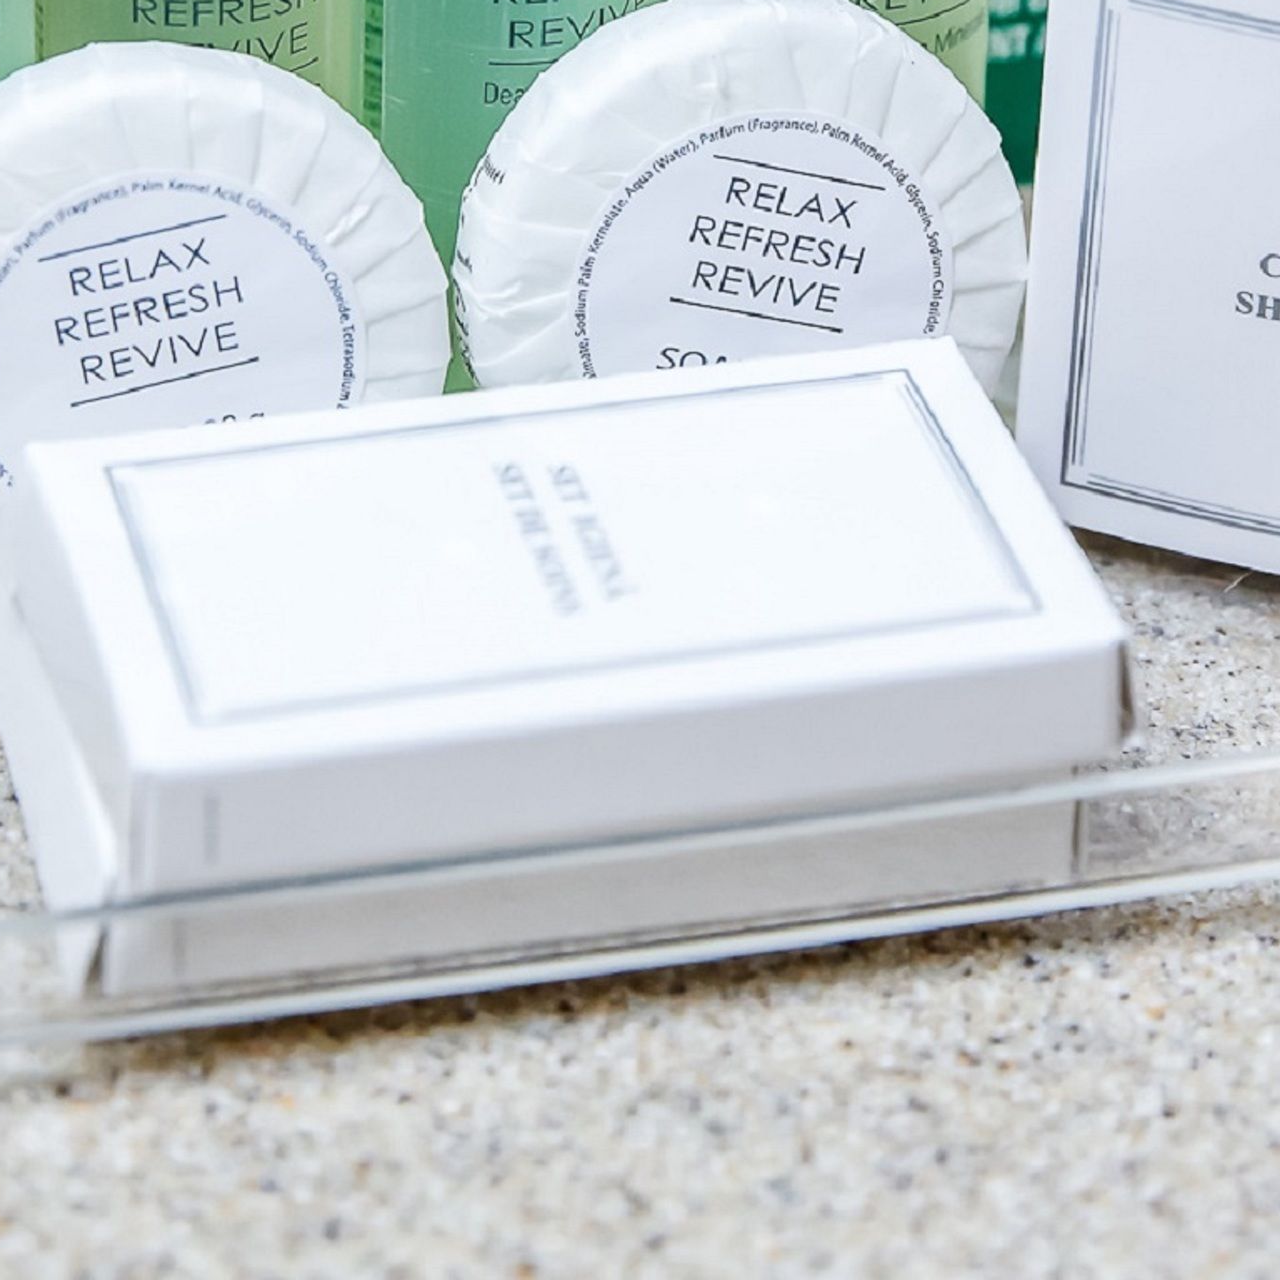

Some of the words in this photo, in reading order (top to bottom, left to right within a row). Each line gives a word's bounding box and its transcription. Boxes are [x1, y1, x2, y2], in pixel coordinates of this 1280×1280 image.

[699, 122, 745, 145] Parfum
[821, 122, 851, 143] Palm
[850, 133, 889, 164] Kernel
[624, 169, 654, 199] Aqua
[725, 176, 859, 229] RELAX
[68, 237, 212, 297] RELAX
[688, 216, 866, 276] REFRESH
[926, 231, 943, 278] Sodium
[577, 255, 597, 288] Palm
[692, 260, 842, 315] REVIVE
[54, 275, 246, 347] REFRESH
[575, 289, 589, 338] Sodium
[79, 321, 239, 386] REVIVE
